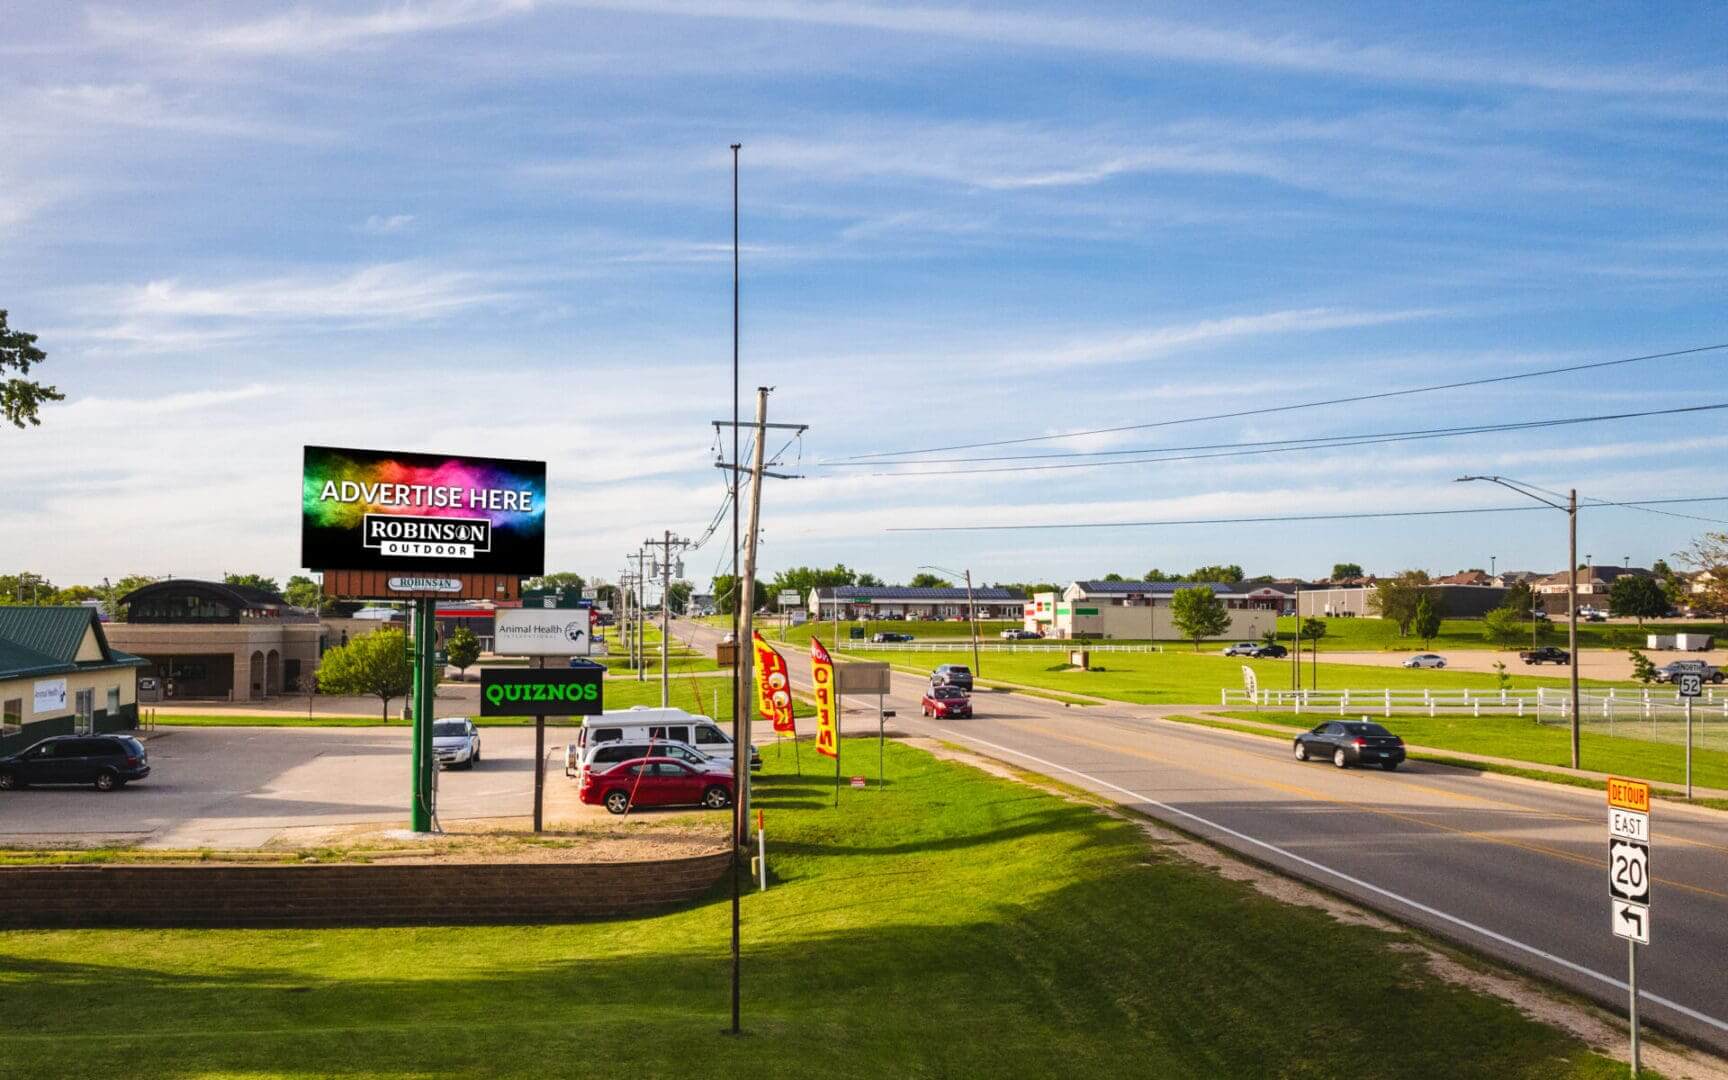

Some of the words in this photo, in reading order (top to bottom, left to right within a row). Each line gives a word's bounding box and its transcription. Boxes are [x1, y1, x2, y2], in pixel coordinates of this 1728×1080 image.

[320, 480, 463, 508] ADVERTISE
[469, 488, 532, 511] HERE
[371, 521, 485, 541] ROBINSON
[389, 543, 467, 555] OUTDOOR
[400, 577, 451, 589] ROBINSON
[499, 625, 532, 634] Animal
[534, 625, 562, 634] Health
[486, 683, 598, 706] QUIZNOS
[1683, 679, 1698, 692] 52
[1612, 784, 1645, 804] DETOUR
[1615, 814, 1641, 835] EAST
[1616, 855, 1642, 887] 20
